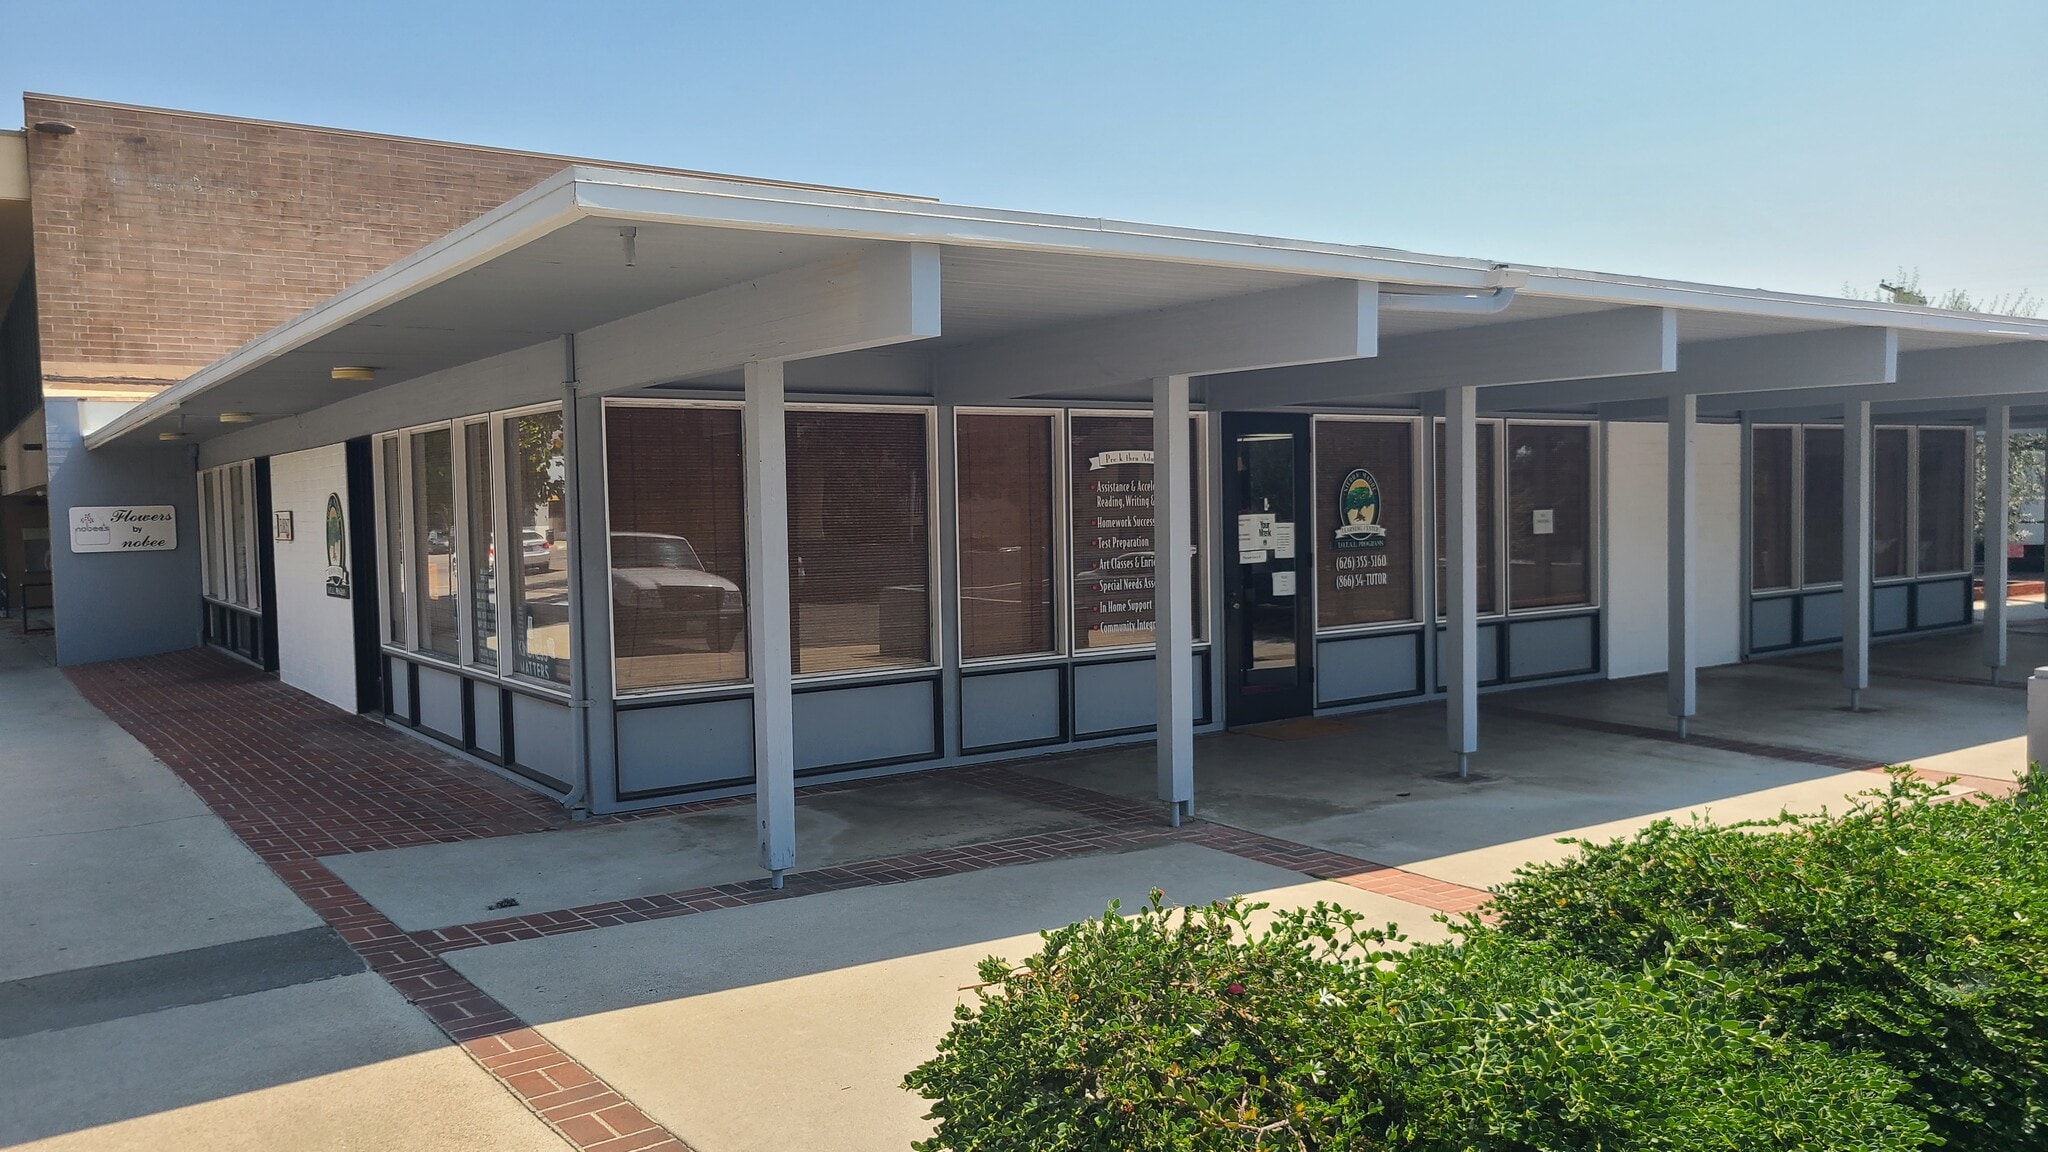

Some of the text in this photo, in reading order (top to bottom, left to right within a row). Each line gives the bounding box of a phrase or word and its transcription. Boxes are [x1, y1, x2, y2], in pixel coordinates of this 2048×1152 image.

[1105, 453, 1117, 463] Pre
[1141, 452, 1154, 462] Adu
[1097, 479, 1155, 493] Assistance & Accel
[1343, 472, 1377, 492] SIERRA MADRE
[1096, 495, 1125, 510] Reading,
[1125, 494, 1150, 509] Writing
[110, 509, 173, 523] Flowers
[1097, 515, 1155, 529] Homework Success
[132, 525, 143, 534] by
[121, 535, 167, 548] nobee
[1097, 535, 1150, 550] Test Preparation
[1358, 539, 1384, 547] PROGRAMS
[1099, 557, 1110, 570] Art
[1110, 556, 1134, 570] Classes
[1134, 556, 1140, 568] &
[1336, 554, 1387, 571] (626) 355-5160
[1099, 576, 1155, 594] Special Needs Ass
[1336, 572, 1387, 590] (866) 54-TUTOR
[1099, 598, 1153, 613] In Home Support
[1099, 618, 1156, 634] Community Integr
